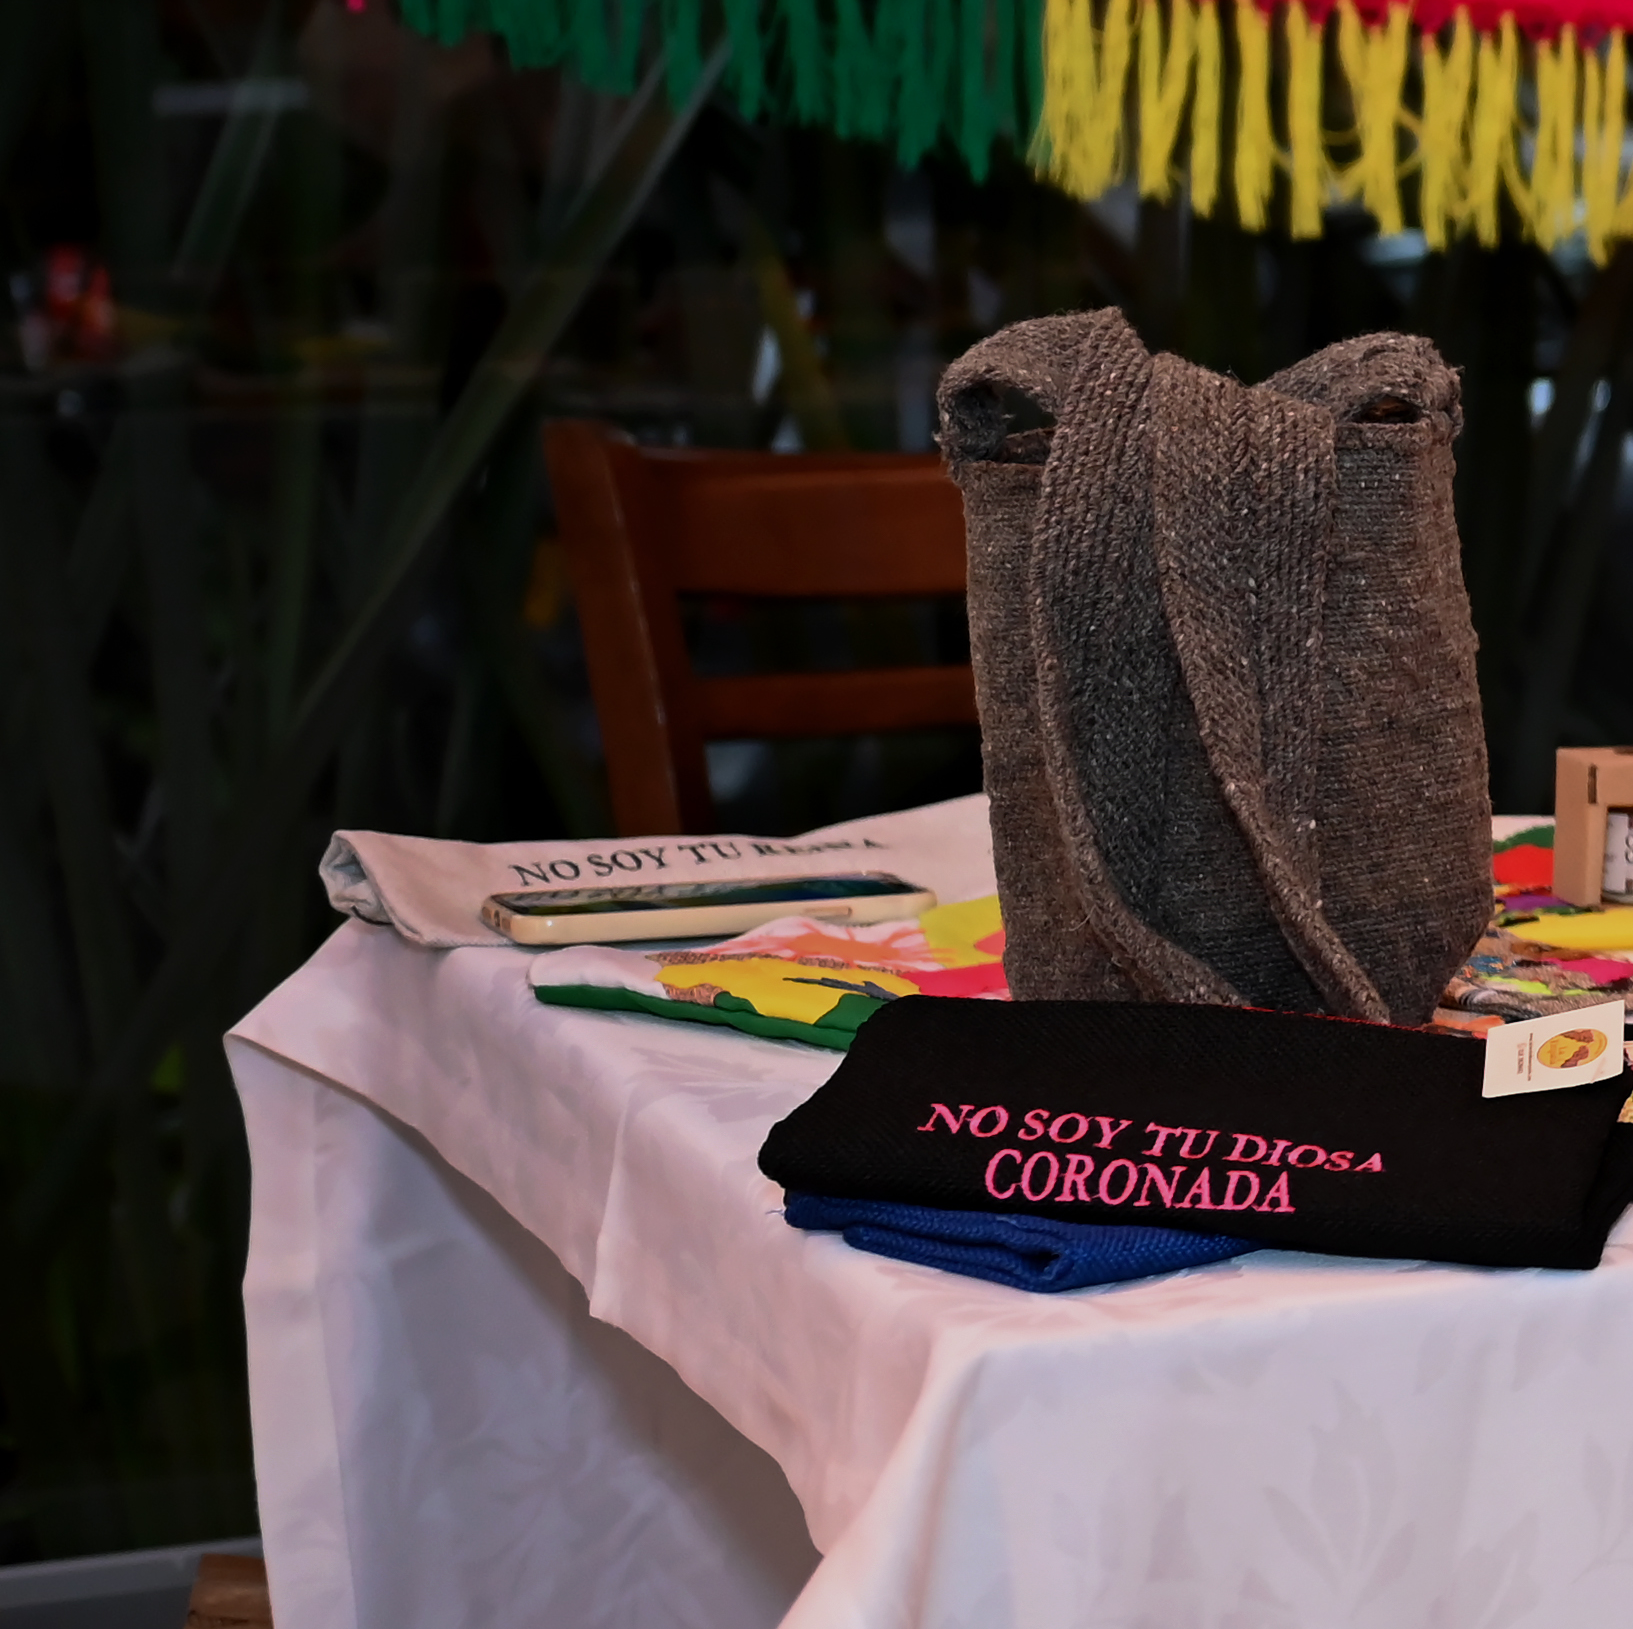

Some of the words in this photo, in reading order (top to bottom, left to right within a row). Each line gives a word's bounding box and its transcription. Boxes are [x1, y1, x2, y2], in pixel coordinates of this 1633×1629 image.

[509, 858, 581, 887] NO
[587, 845, 669, 877] SOY
[678, 841, 742, 865] TU
[916, 1102, 1009, 1138] NO
[1018, 1108, 1133, 1150] SOY
[1141, 1121, 1219, 1159] TU
[1222, 1132, 1387, 1173] DIOSA
[984, 1148, 1297, 1214] CORONADA
